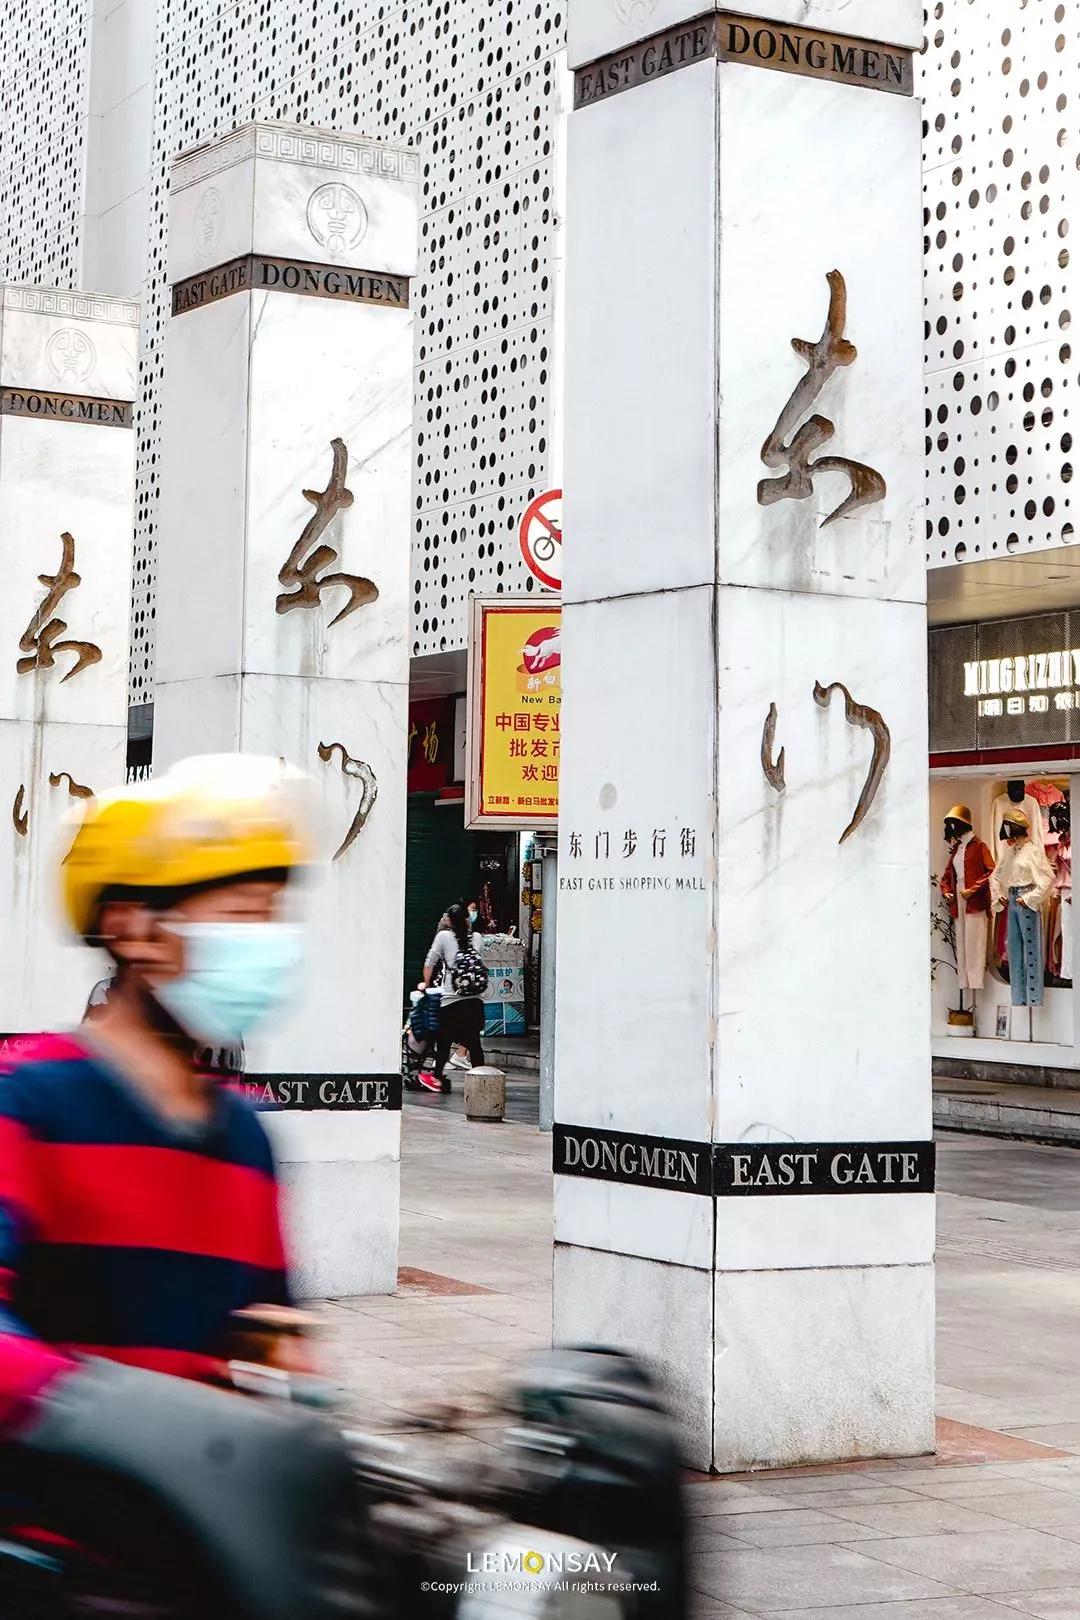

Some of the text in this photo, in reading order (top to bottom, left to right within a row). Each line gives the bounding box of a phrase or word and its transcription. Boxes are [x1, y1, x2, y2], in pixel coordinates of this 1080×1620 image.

[579, 26, 707, 102] EAST GATE
[726, 23, 905, 85] DONGMEN
[174, 265, 247, 311] EAST GATE
[261, 263, 406, 302] DONGMEN
[9, 392, 126, 423] DONGMEN
[521, 695, 544, 704] New
[521, 764, 559, 782] 欢迎
[568, 827, 697, 860] 东门步行街
[559, 877, 706, 890] EAST GATE SHOPPING MALL
[245, 1080, 390, 1104] EAST GATE
[563, 1136, 699, 1184] DONGMEN
[730, 1152, 921, 1187] EAST GATE
